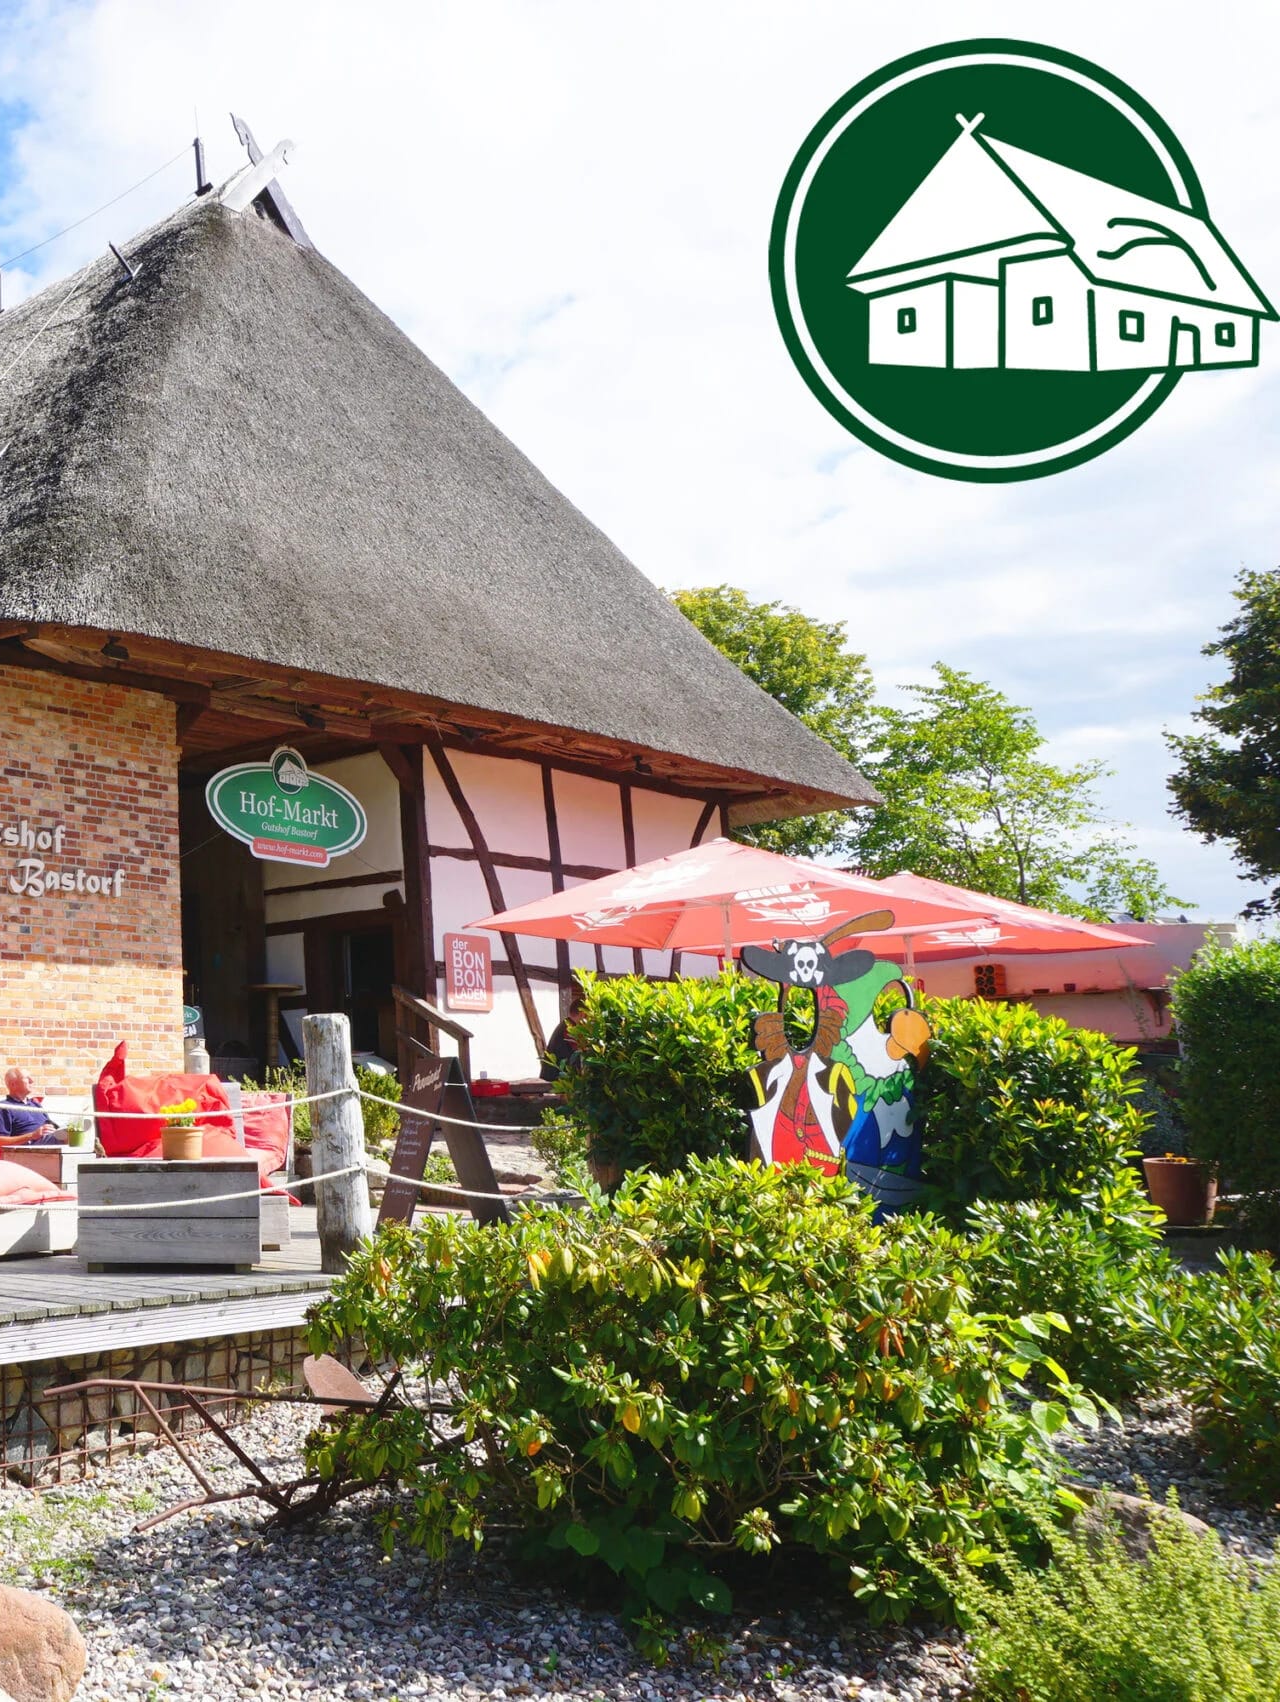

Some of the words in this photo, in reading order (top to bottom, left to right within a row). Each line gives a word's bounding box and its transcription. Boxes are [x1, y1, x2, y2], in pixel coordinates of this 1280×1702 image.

[239, 790, 339, 829] Hof-Markt
[261, 821, 291, 836] Gutshof
[291, 826, 318, 840] Bastorf
[9, 858, 125, 897] Bastorf
[452, 938, 468, 950] der
[453, 950, 485, 970] BON
[454, 968, 486, 988] BON
[454, 987, 487, 1001] LADEN
